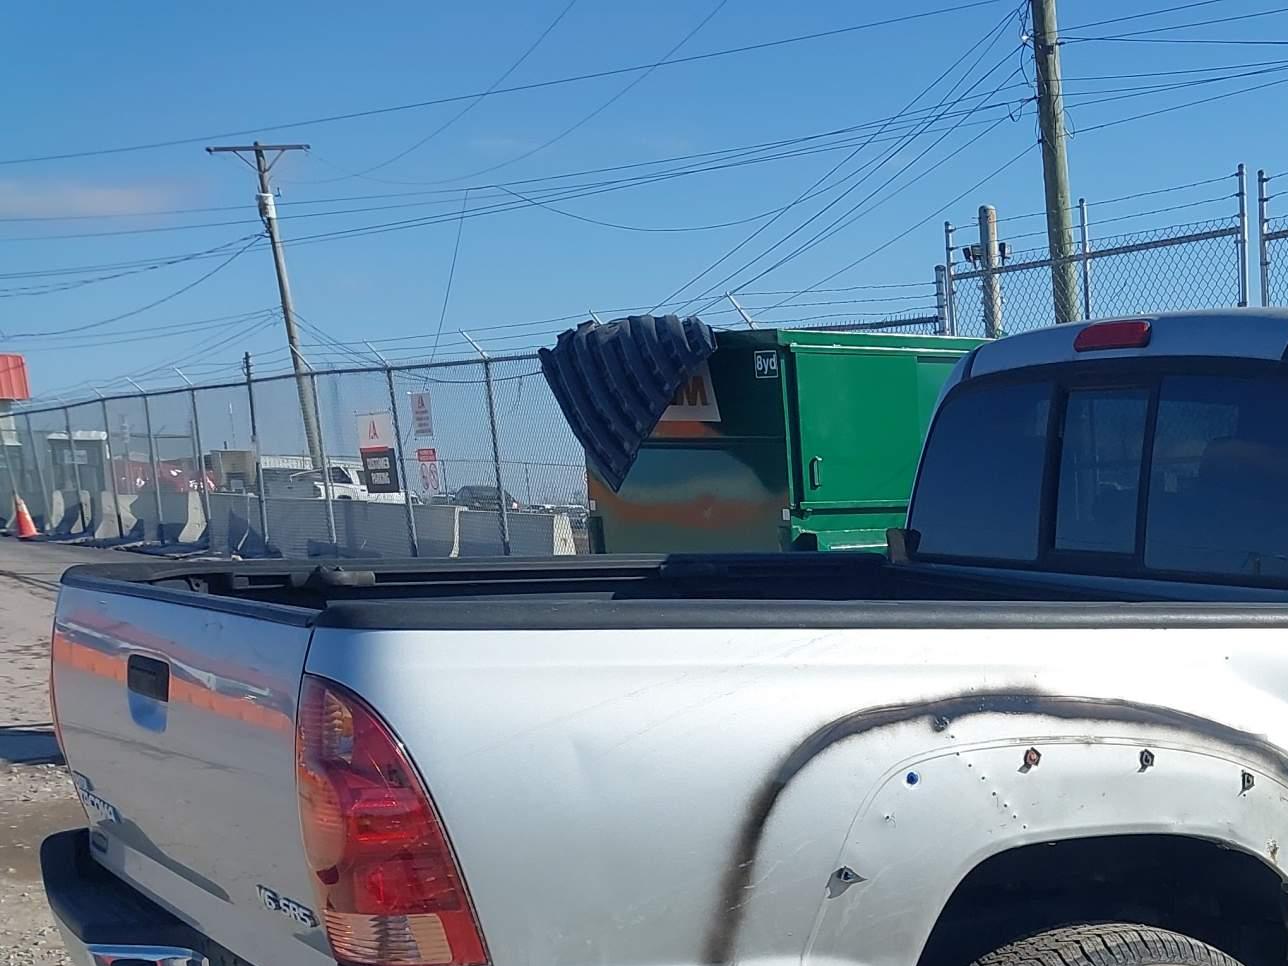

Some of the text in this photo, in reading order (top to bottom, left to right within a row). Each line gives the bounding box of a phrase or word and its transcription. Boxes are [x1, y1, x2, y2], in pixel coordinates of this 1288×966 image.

[756, 354, 777, 374] 8yd
[255, 884, 315, 929] V6 SR5
